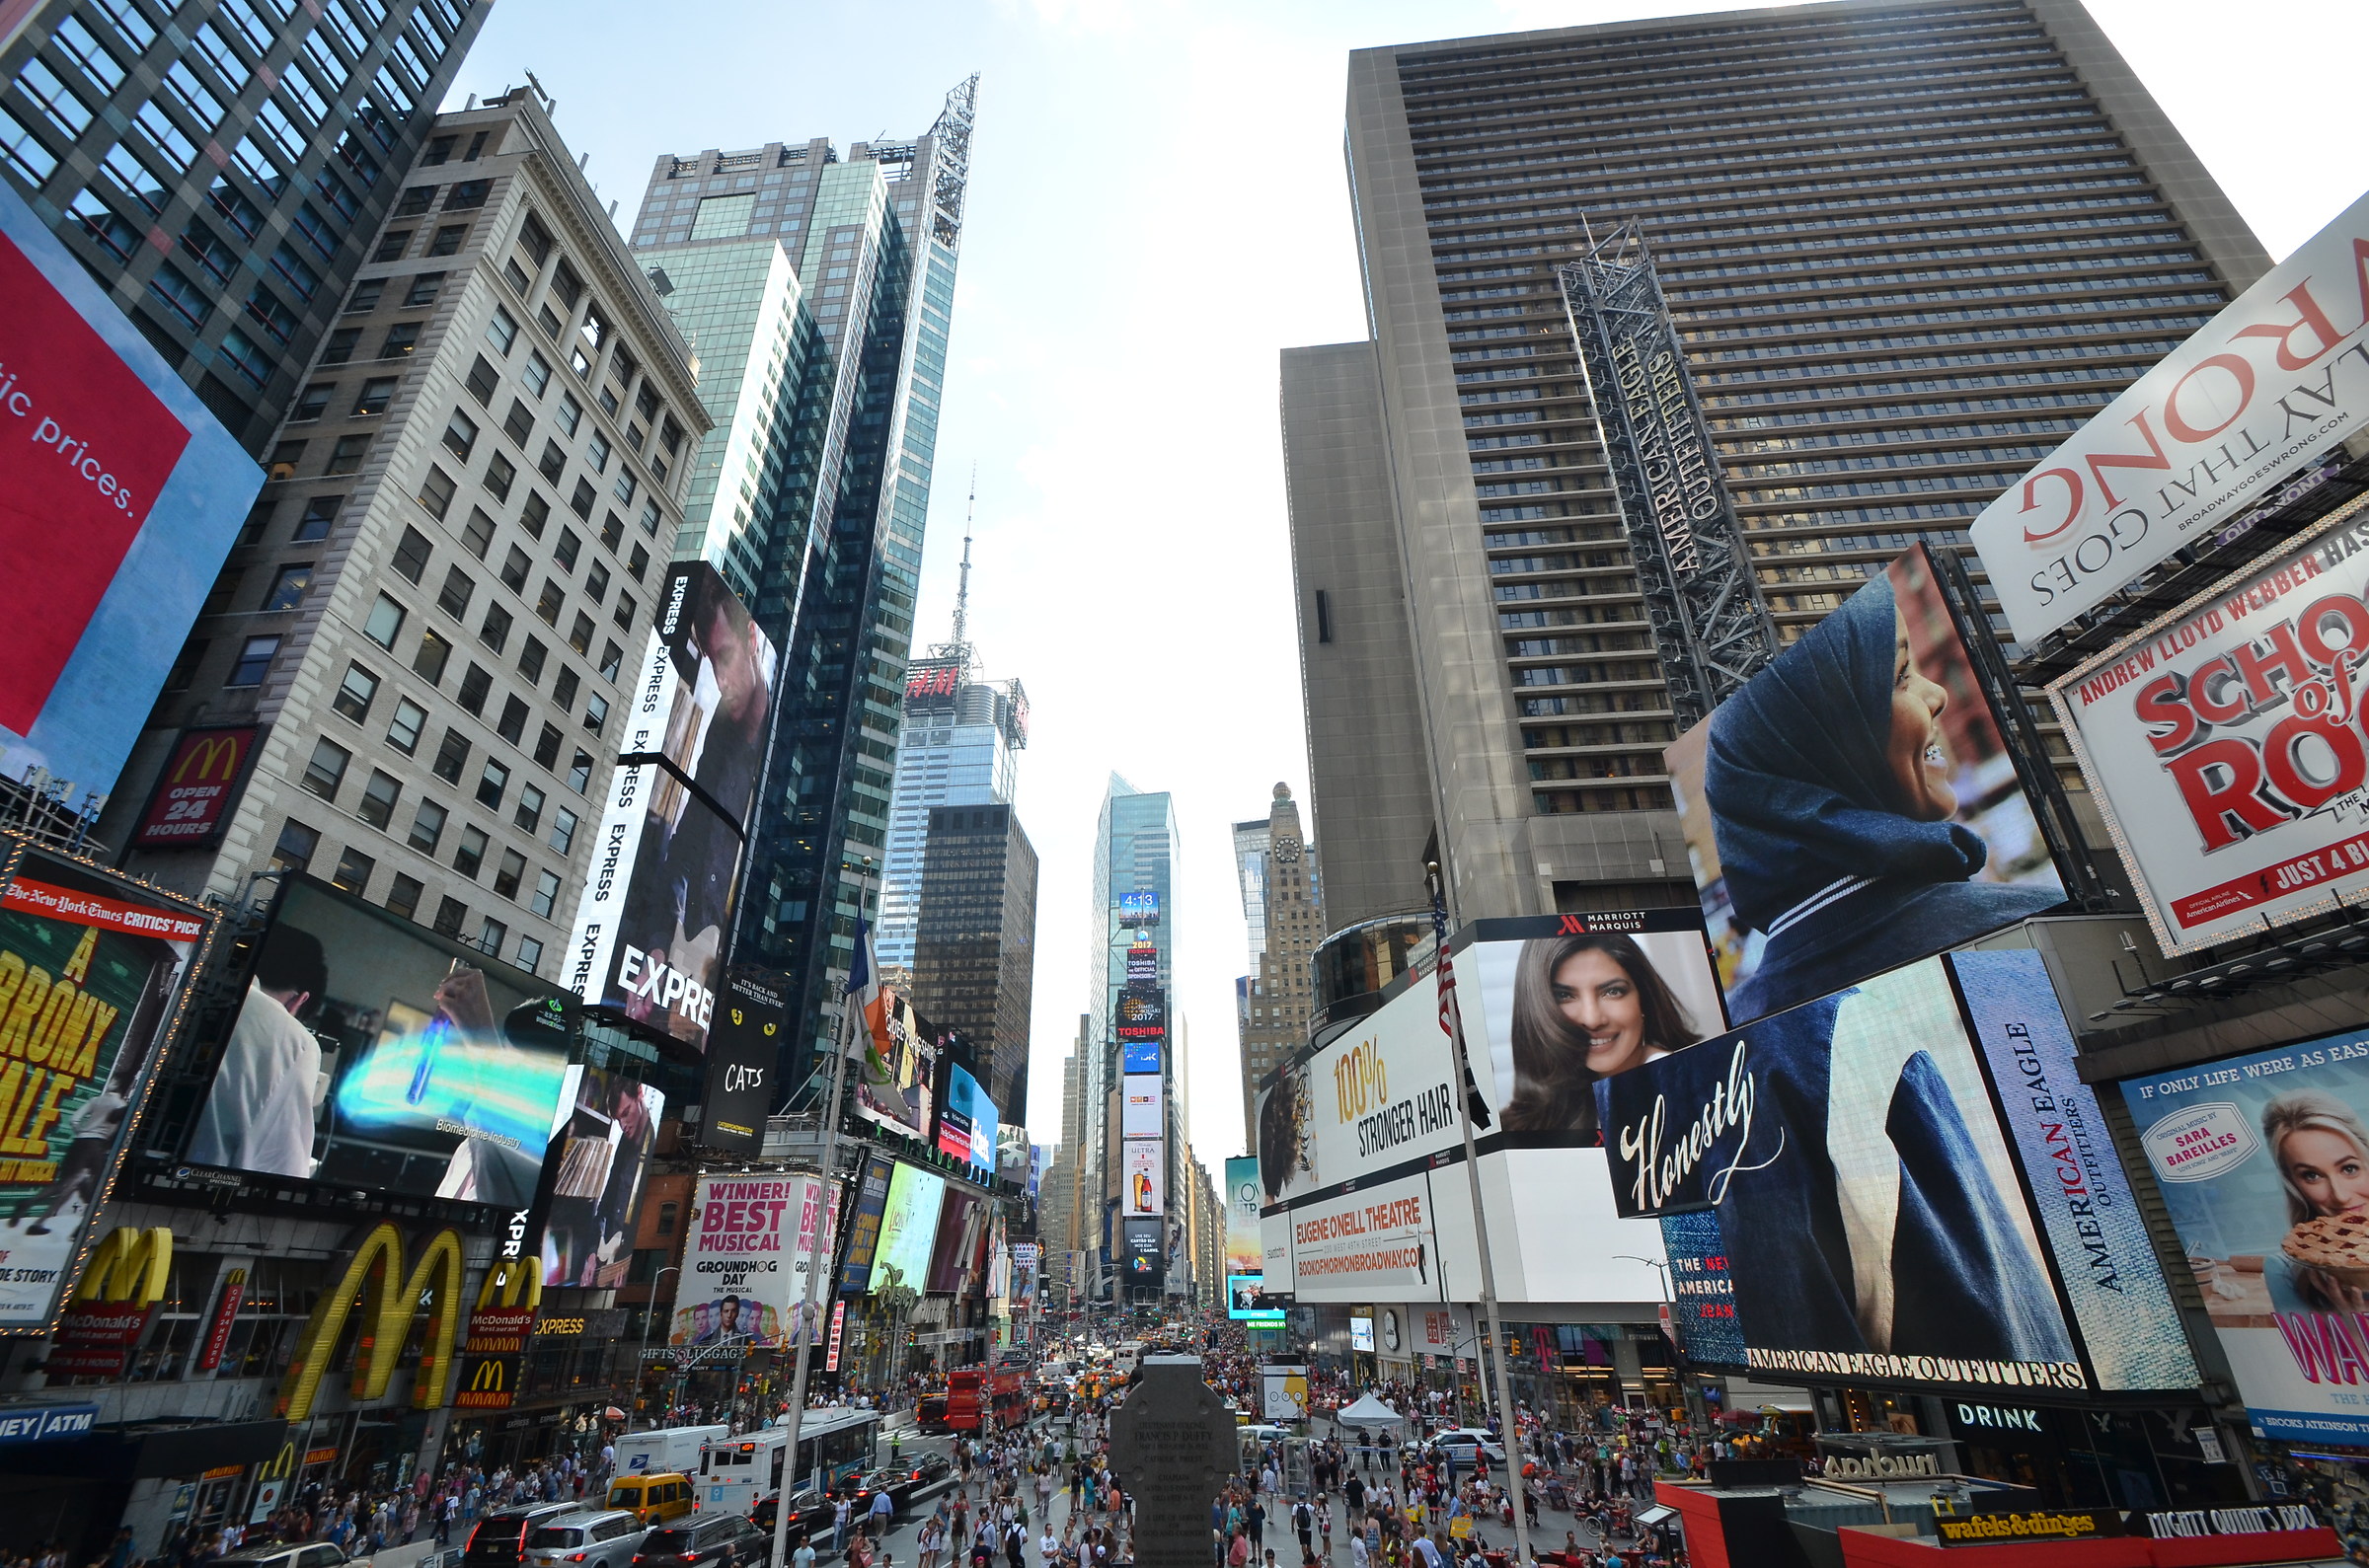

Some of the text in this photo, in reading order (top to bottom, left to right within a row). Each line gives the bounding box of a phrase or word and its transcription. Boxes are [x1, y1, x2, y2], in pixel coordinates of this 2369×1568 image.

[0, 362, 134, 518] ic prices.
[1647, 349, 1719, 521] OUTFITTERS
[1612, 334, 1701, 573] AMERICAN EAGLE
[2178, 411, 2350, 532] BROADWAYGOESWRONG.COM
[2029, 426, 2270, 608] THAT GOES
[662, 575, 689, 635] EXPRESS
[2157, 608, 2225, 661] LLOYD
[2224, 553, 2323, 622] WEBBER
[642, 644, 670, 713] EXPRESS
[905, 667, 959, 698] H&M
[2292, 648, 2360, 726] of
[618, 729, 650, 808] EXRESS
[2161, 688, 2369, 858] RO
[169, 785, 222, 799] OPEN
[2337, 793, 2360, 812] THE
[164, 799, 209, 821] 24
[145, 822, 212, 836] HOURS
[594, 823, 627, 902] EXPRESS
[2276, 849, 2347, 890] JUST 4
[5, 883, 28, 900] The
[28, 889, 57, 907] New
[56, 895, 88, 914] York
[87, 902, 123, 923] Times
[175, 920, 202, 935] PICK
[1124, 894, 1153, 907] 4:13
[2185, 895, 2241, 920] American Airlines
[1587, 911, 1646, 923] MARRIOTT
[1589, 920, 1642, 931] MARQUIS
[62, 926, 100, 983] A
[1132, 940, 1152, 949] 2017
[617, 943, 716, 1034] EXPRE
[752, 983, 767, 995] BACK
[767, 988, 779, 999] AND
[752, 991, 768, 1003] THAN
[1117, 1026, 1165, 1036] TOSHIBA
[725, 1063, 764, 1092] CATS
[1335, 1033, 1388, 1125] 100%
[2139, 1084, 2155, 1100] IF
[2159, 1076, 2201, 1096] ONLY
[2203, 1068, 2242, 1087] LIFE
[2242, 1057, 2296, 1079] WERE
[2300, 1050, 2326, 1069] AS
[0, 1058, 76, 1156] ALE
[1357, 1083, 1454, 1158] STRONGER HAIR
[435, 1118, 522, 1150] Biomedicine Industry
[1620, 1039, 1785, 1211] Honestly
[2156, 1111, 2218, 1142] ORIGINAL MUSIC BY
[2175, 1127, 2212, 1148] SARA
[2005, 1020, 2124, 1296] AMERICAN EAGLE
[2061, 1097, 2112, 1207] OUTFITTERS
[2166, 1132, 2238, 1167] BAREILLES
[709, 1181, 792, 1201] WINNER!
[701, 1201, 788, 1232] BEST
[856, 1212, 880, 1232] COME
[1296, 1218, 1330, 1244] EUGENE
[1365, 1196, 1421, 1232] THEATRE
[698, 1233, 781, 1252] MUSICAL
[696, 1259, 778, 1274] GROUNDHOG
[722, 1273, 747, 1286] DAY
[1677, 1257, 1702, 1272] THE
[225, 1288, 239, 1317] OPEN
[1700, 1304, 1734, 1318] JEAN
[64, 1314, 142, 1329] McDonald's
[471, 1315, 531, 1325] McDonald's
[208, 1327, 226, 1365] HOURS
[638, 1348, 747, 1360] GIFTS LUGGAGE
[1750, 1348, 2087, 1389] AMERICAN EAGLE OUTFITTERS
[2331, 1392, 2360, 1405] THE
[44, 1413, 94, 1434] ATM
[506, 1418, 530, 1429] EXPRESS
[1956, 1402, 2043, 1432] DRINK
[2264, 1416, 2359, 1432] BROOKS ATKINSON
[1183, 1431, 1213, 1442] DUFFY
